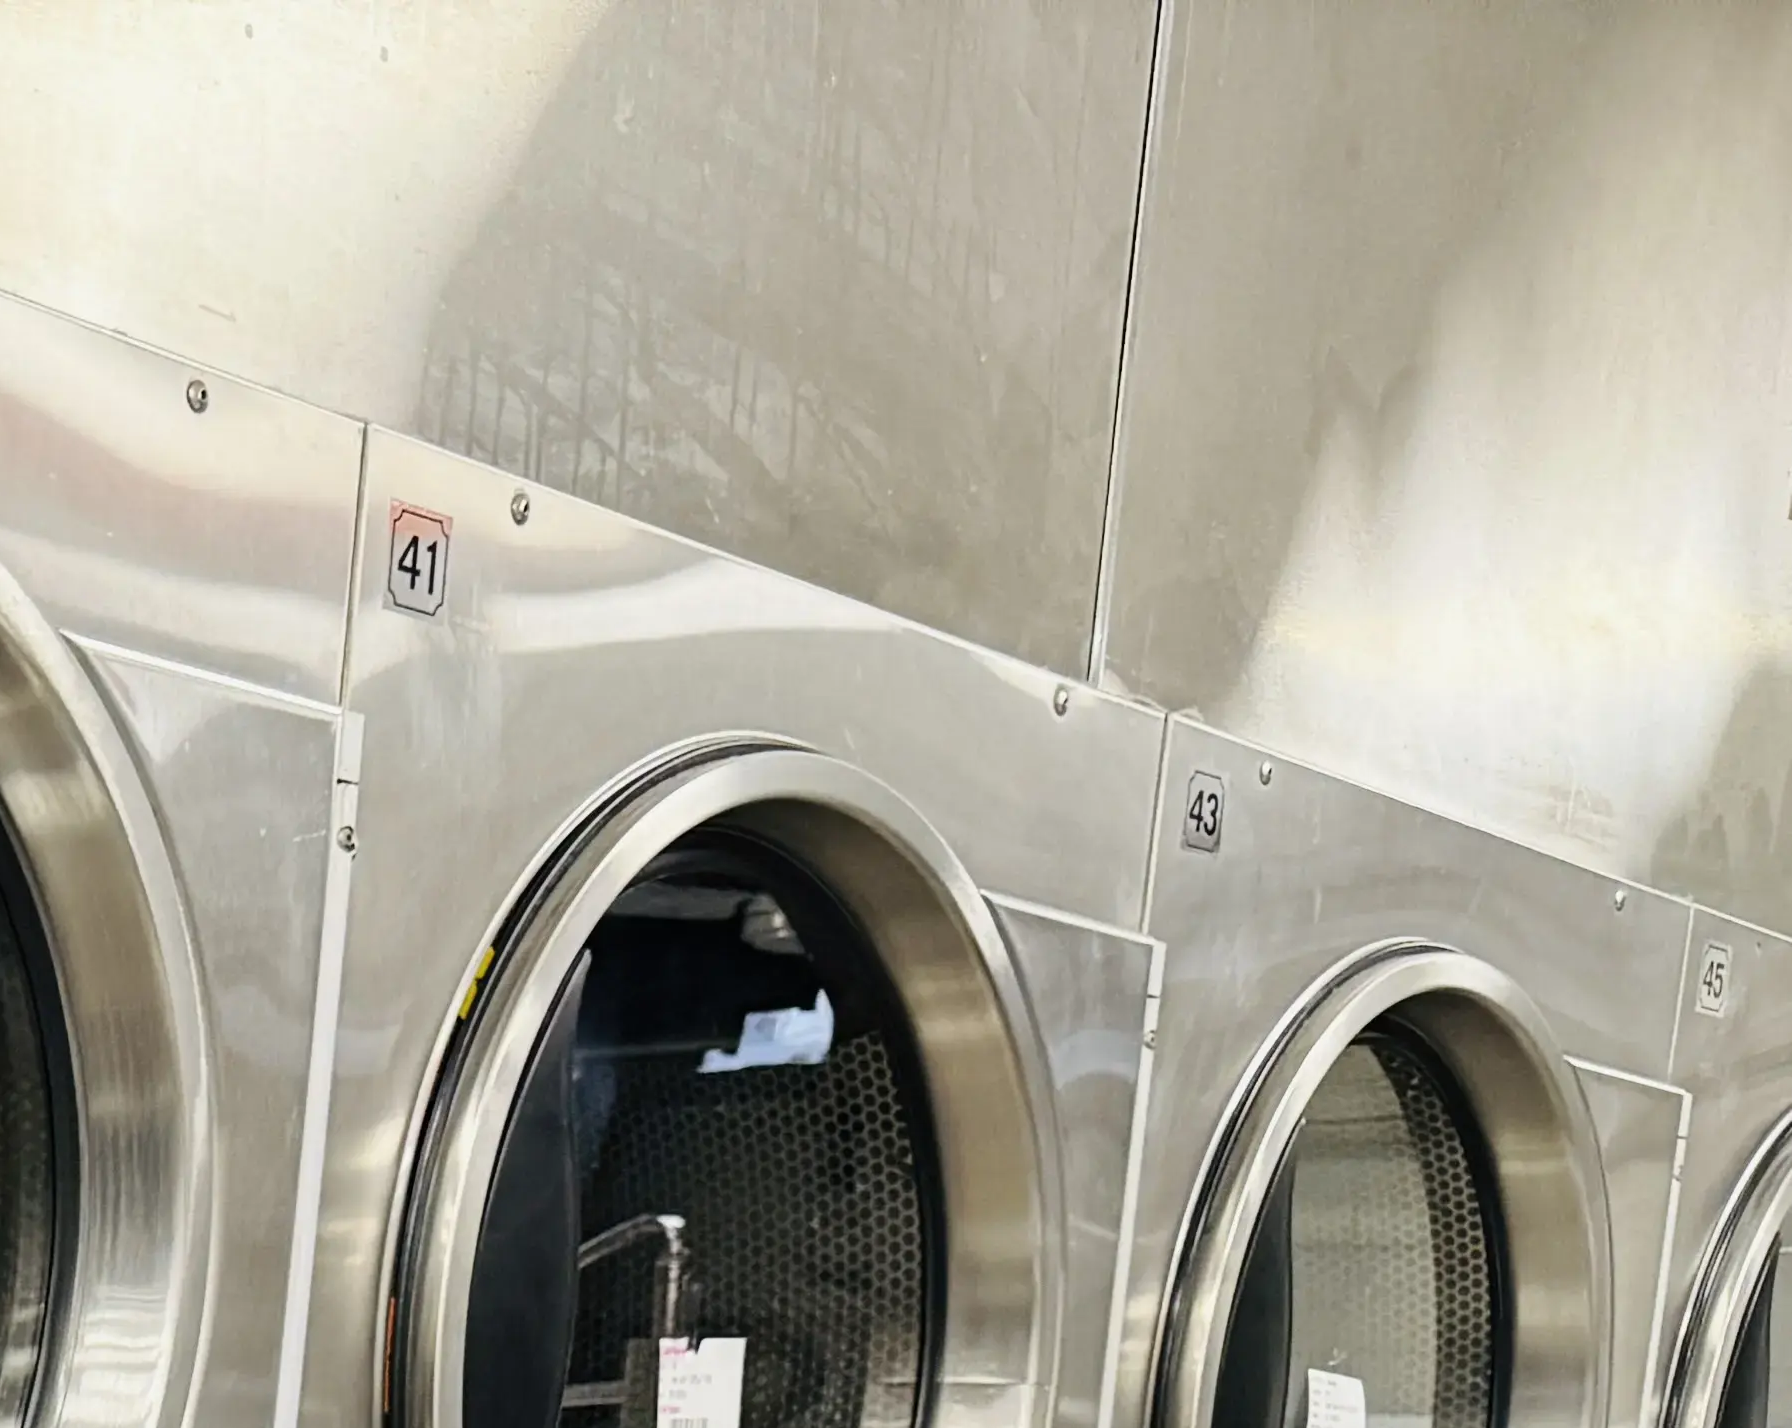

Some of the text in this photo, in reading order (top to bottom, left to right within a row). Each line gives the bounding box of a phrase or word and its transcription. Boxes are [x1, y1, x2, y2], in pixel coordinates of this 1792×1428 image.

[397, 535, 438, 596] 41
[1189, 788, 1219, 837] 43
[1703, 960, 1725, 998] 45
